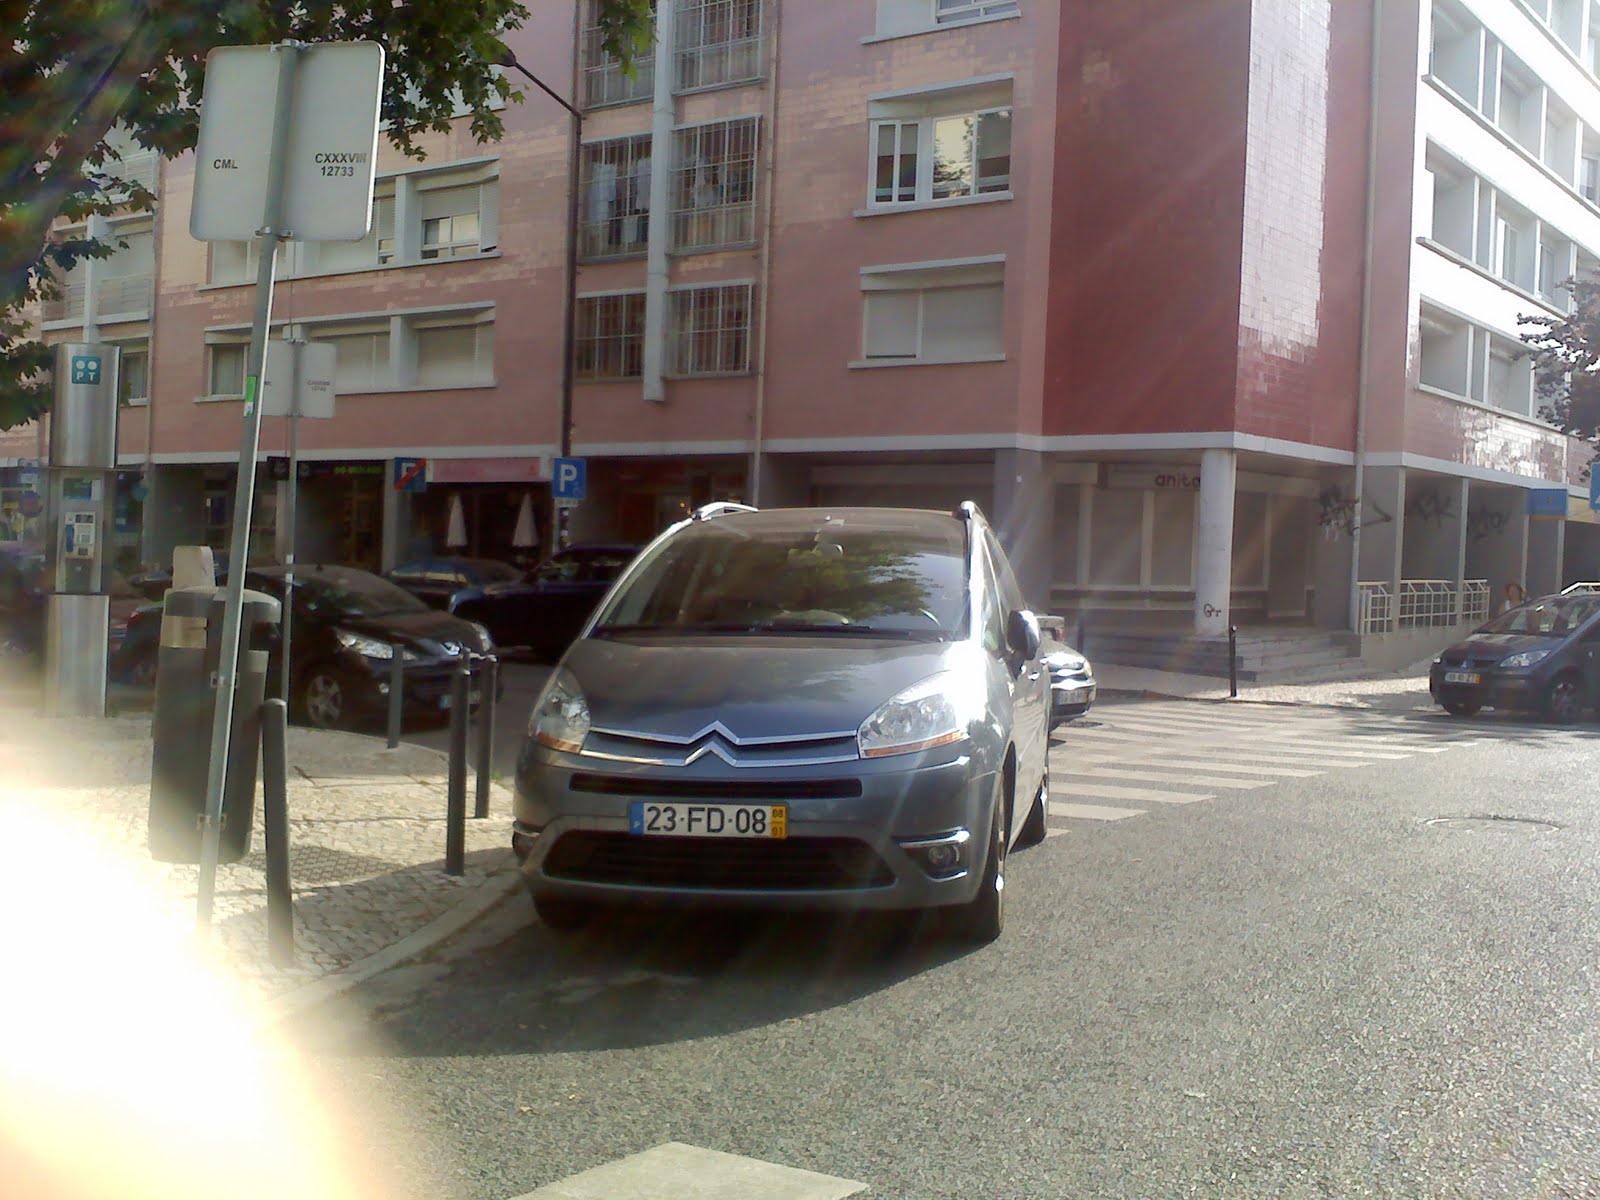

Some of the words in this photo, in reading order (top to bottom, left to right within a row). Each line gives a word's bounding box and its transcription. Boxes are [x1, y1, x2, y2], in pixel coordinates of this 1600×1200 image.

[213, 159, 238, 169] CML
[321, 166, 354, 177] 12733
[560, 464, 577, 492] P
